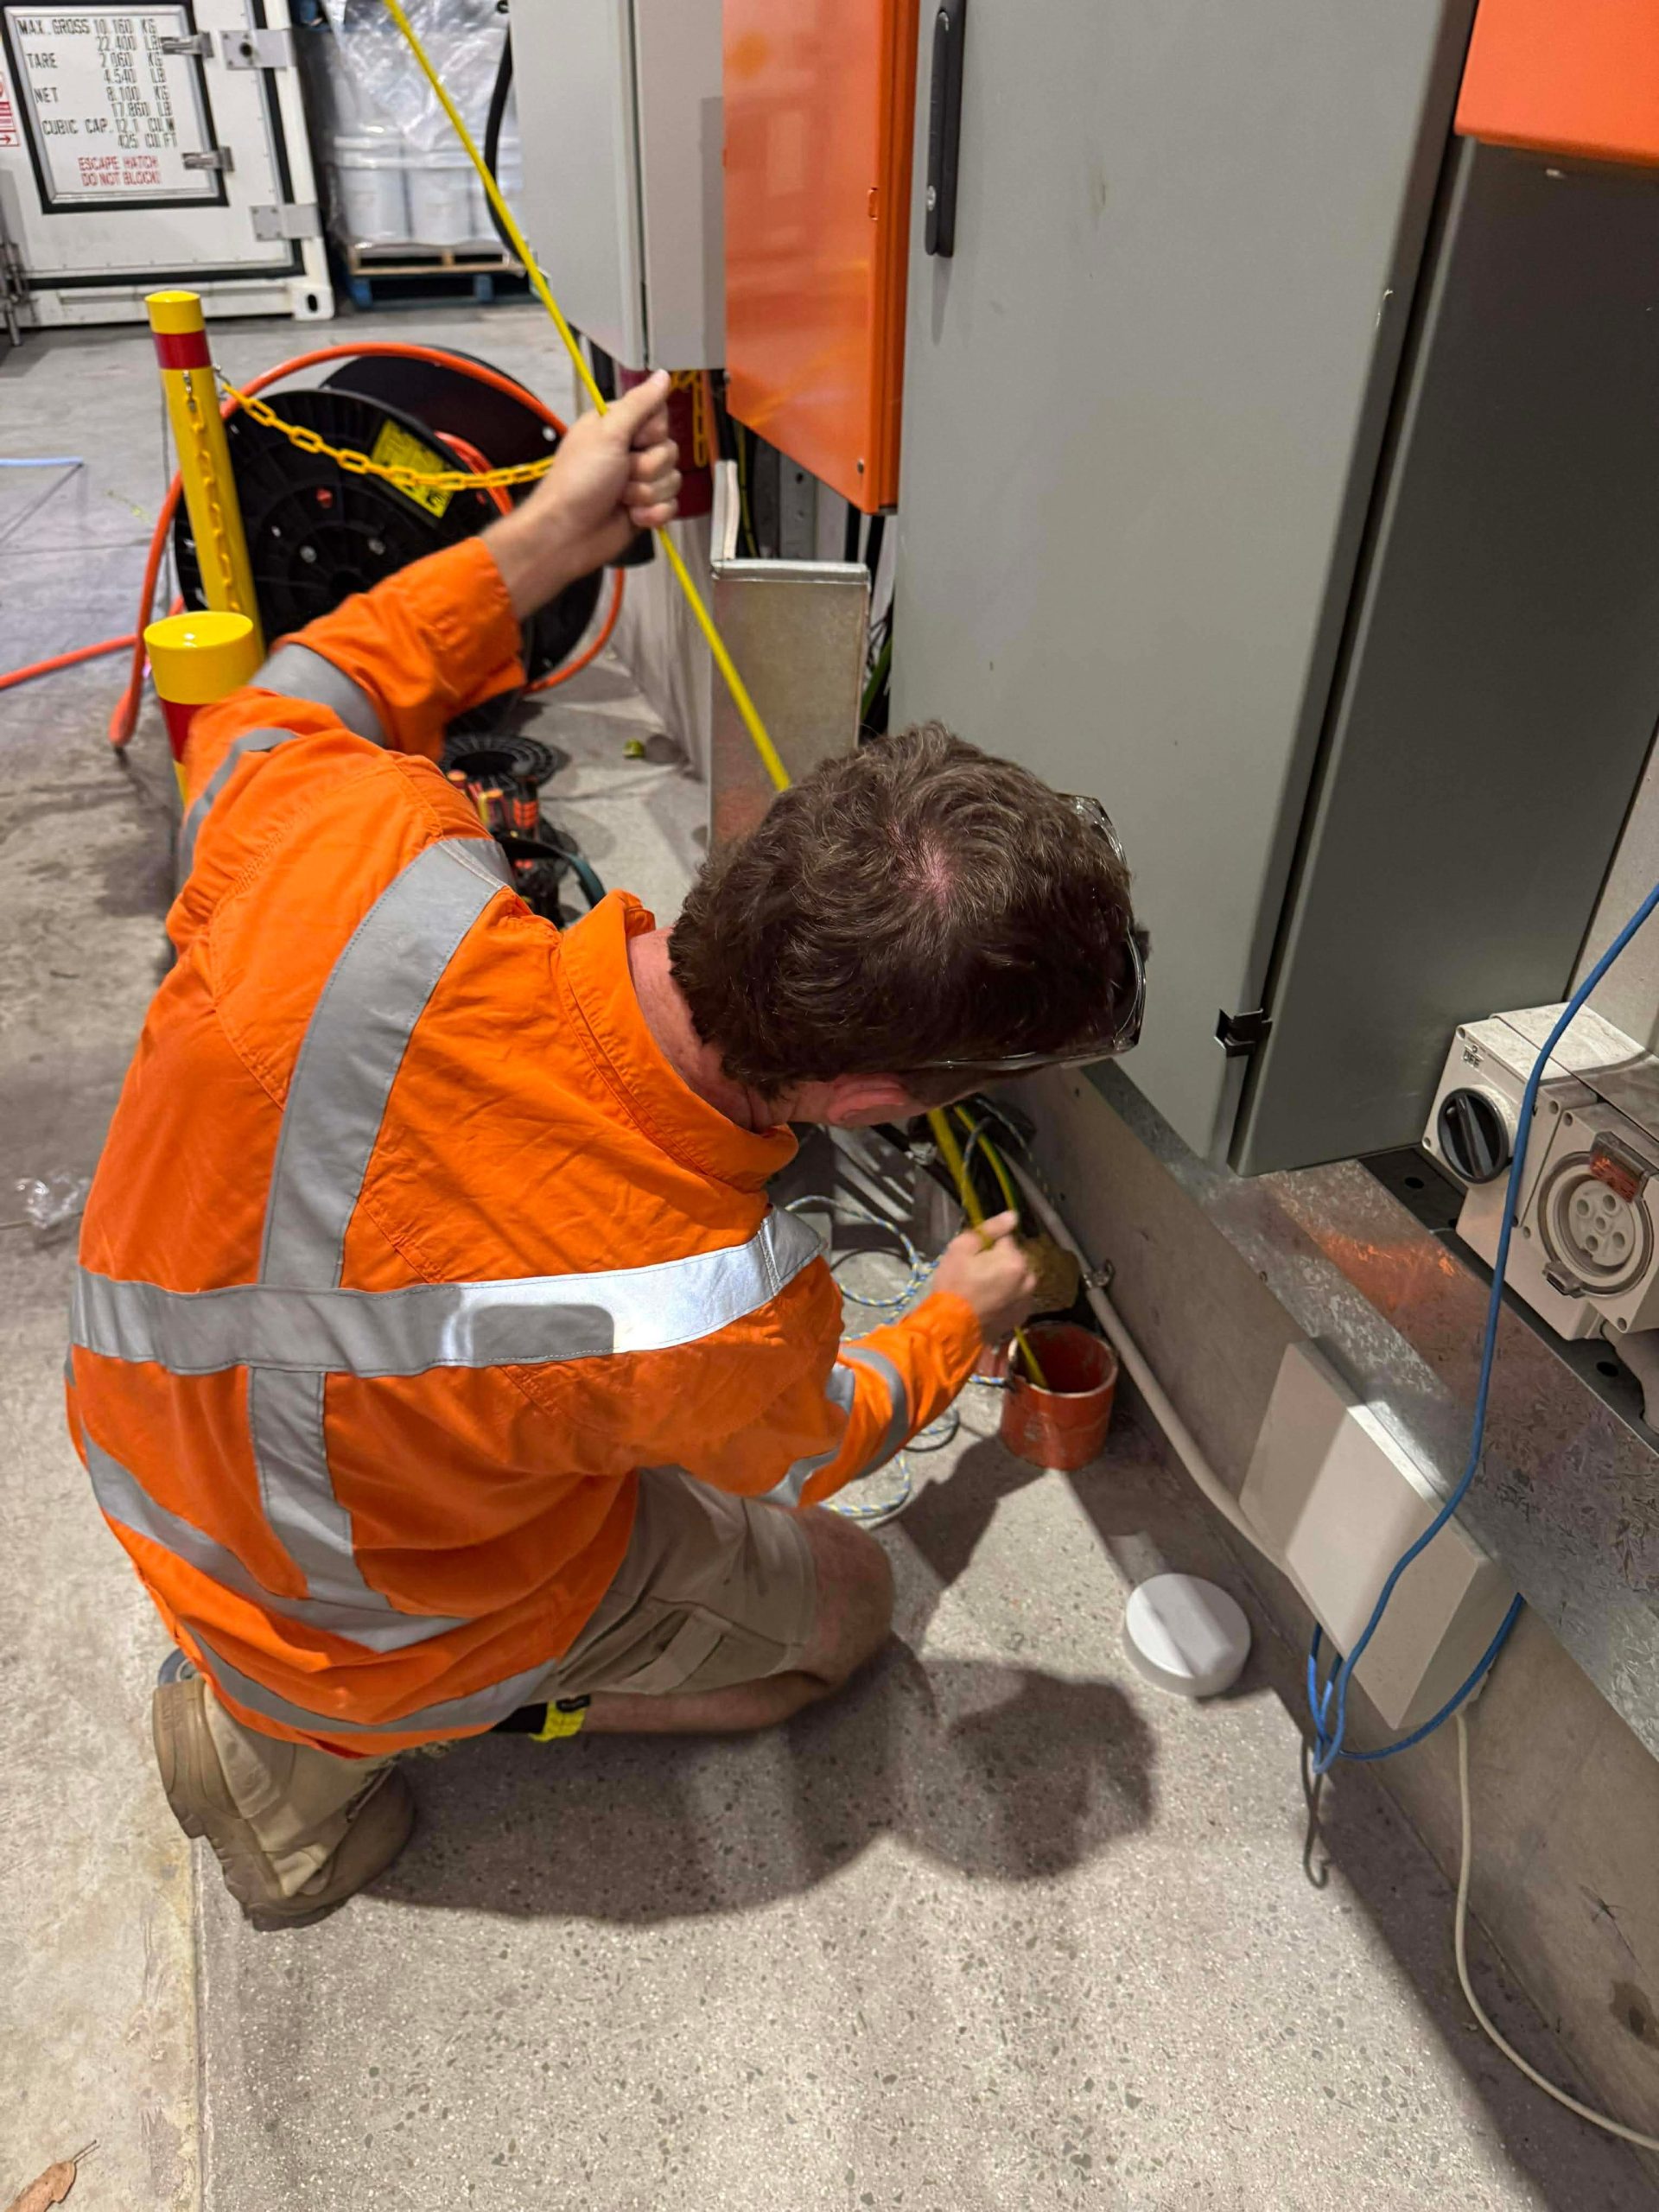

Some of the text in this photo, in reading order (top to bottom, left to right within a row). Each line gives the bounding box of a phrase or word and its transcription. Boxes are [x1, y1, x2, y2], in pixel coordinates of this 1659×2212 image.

[52, 19, 91, 35] GROSS
[141, 18, 157, 34] KG
[26, 53, 58, 68] TARE
[148, 52, 164, 67] KG
[151, 68, 167, 83] LB
[34, 87, 59, 103] NET
[155, 86, 170, 100] KG
[157, 101, 173, 116] LB
[41, 119, 79, 135] CUBIC
[118, 134, 139, 149] 425
[78, 156, 159, 171] ESCAPE HATCH
[81, 173, 98, 187] DO
[99, 172, 122, 186] NOT
